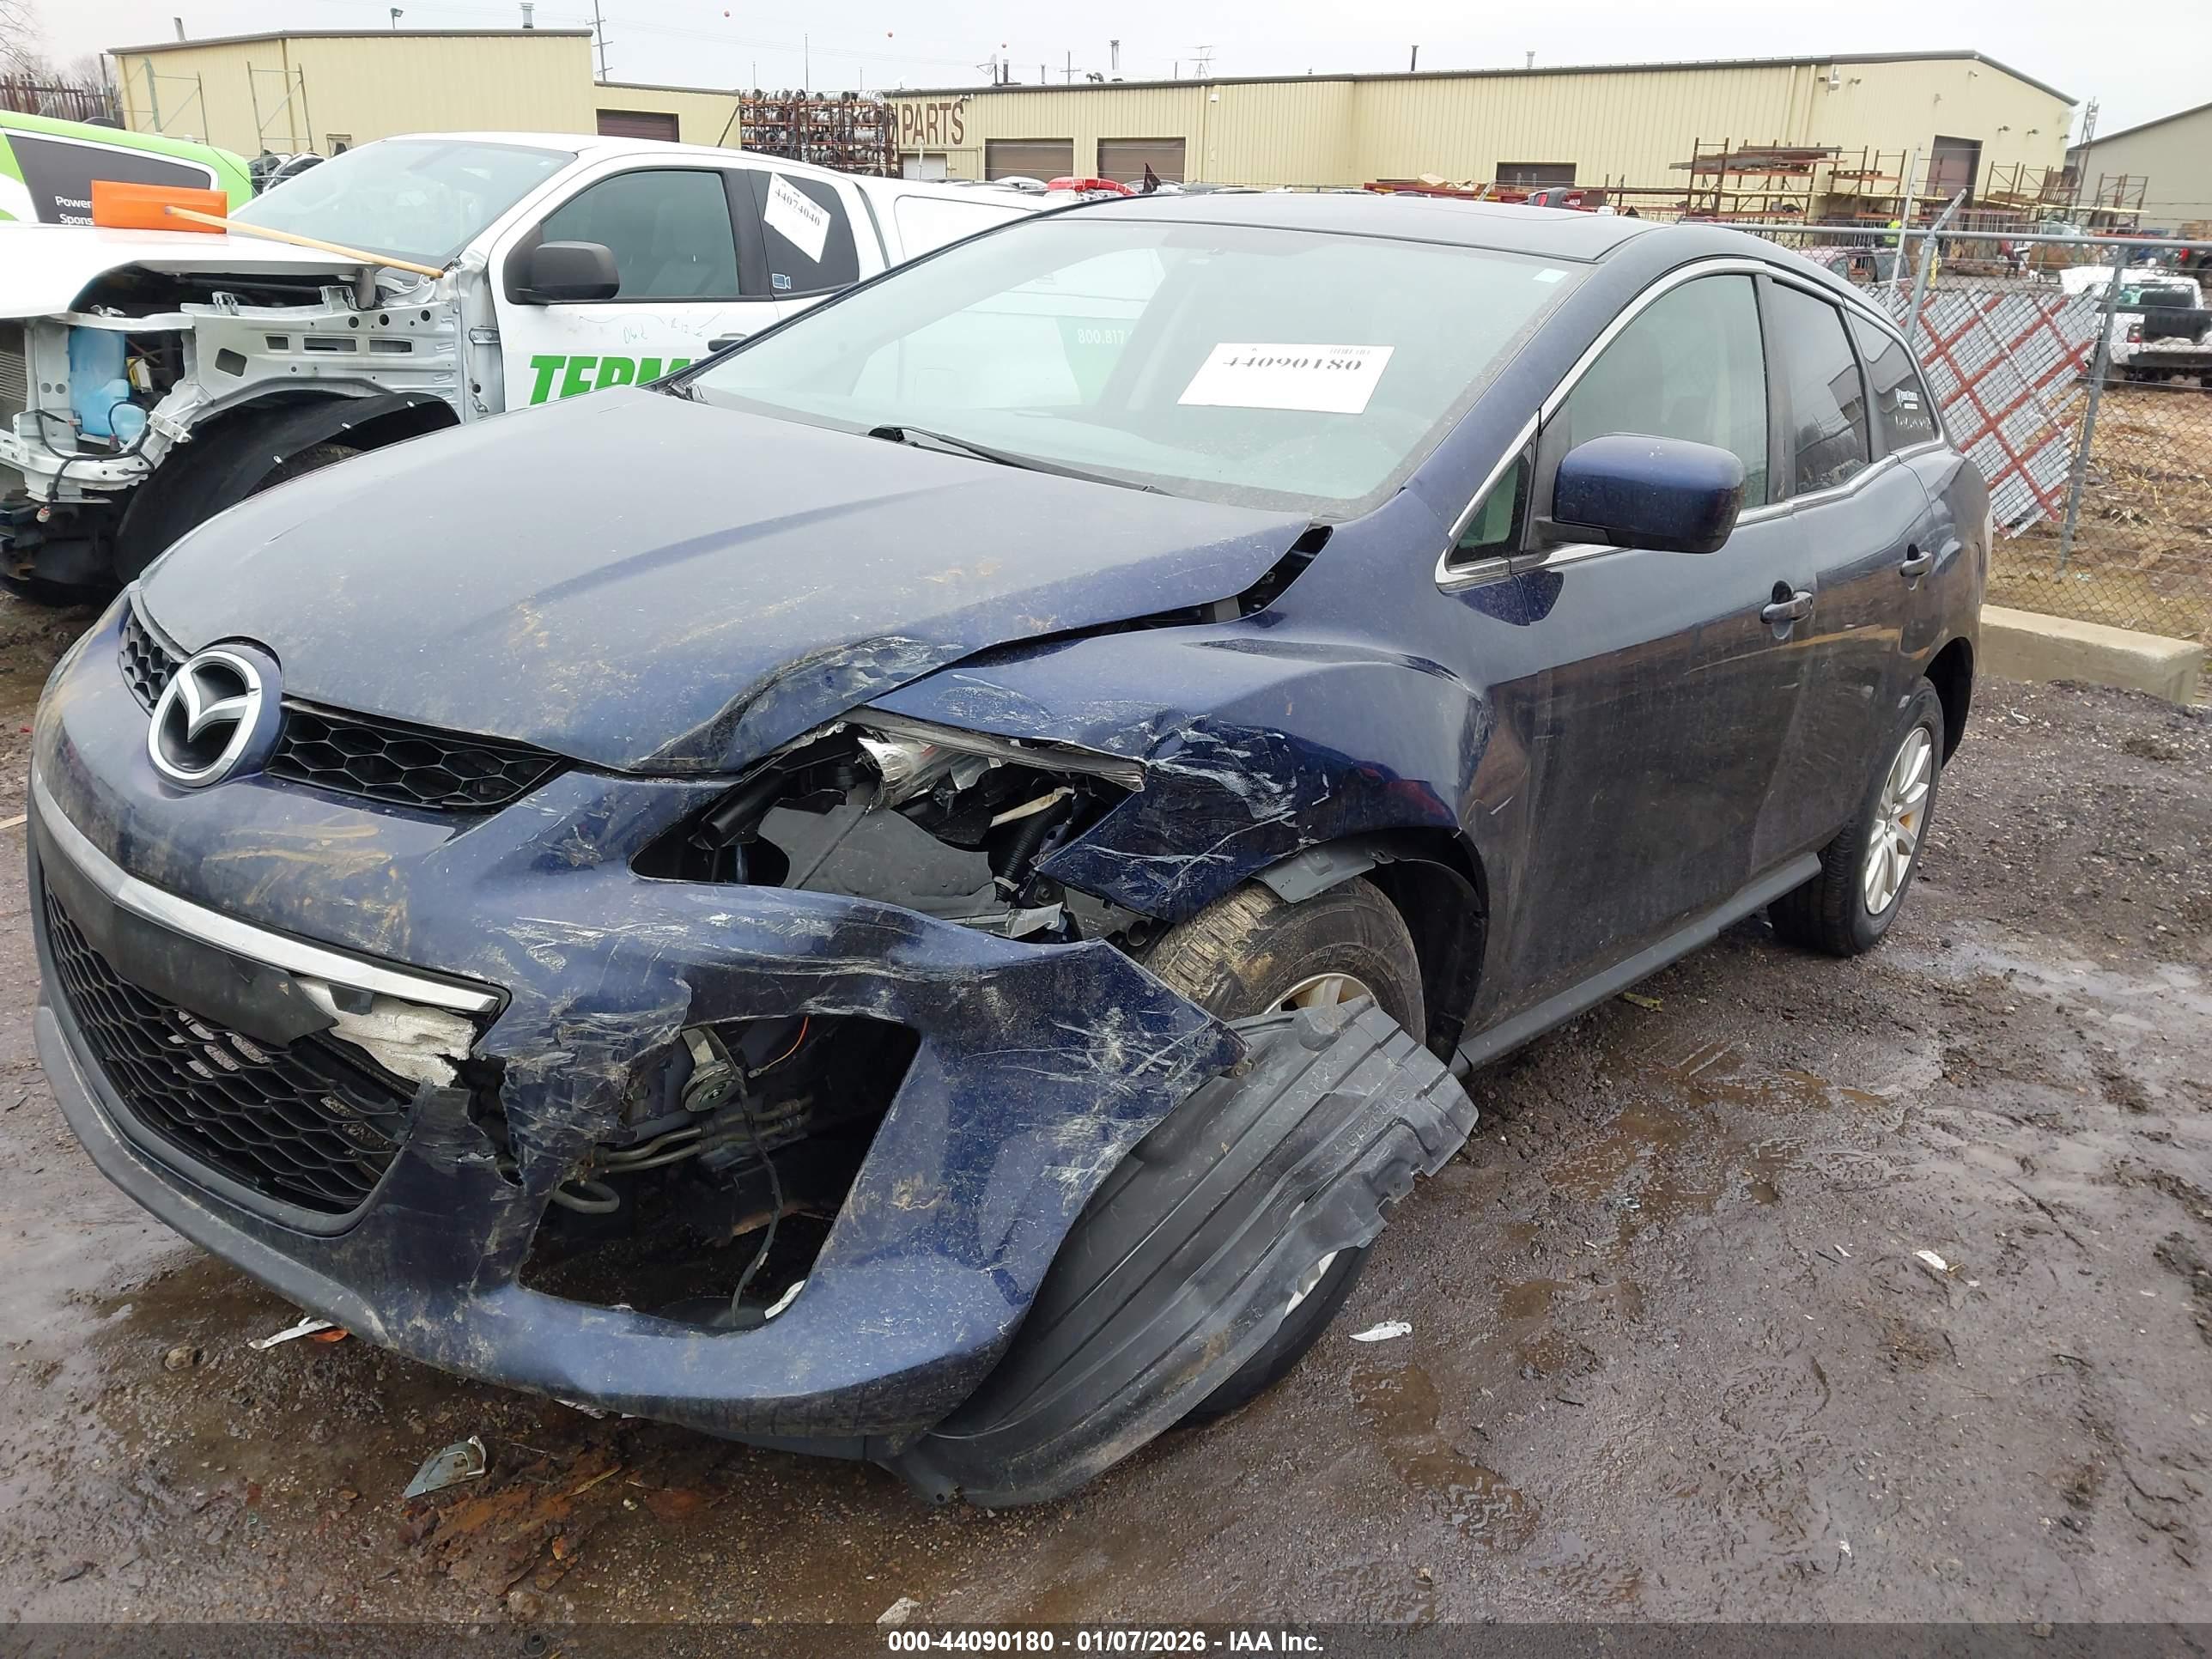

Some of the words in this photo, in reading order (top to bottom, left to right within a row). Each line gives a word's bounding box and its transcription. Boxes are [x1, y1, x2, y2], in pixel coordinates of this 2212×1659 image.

[902, 100, 964, 144] PARTS
[775, 188, 821, 227] 44074040
[1223, 356, 1363, 371] 44090180
